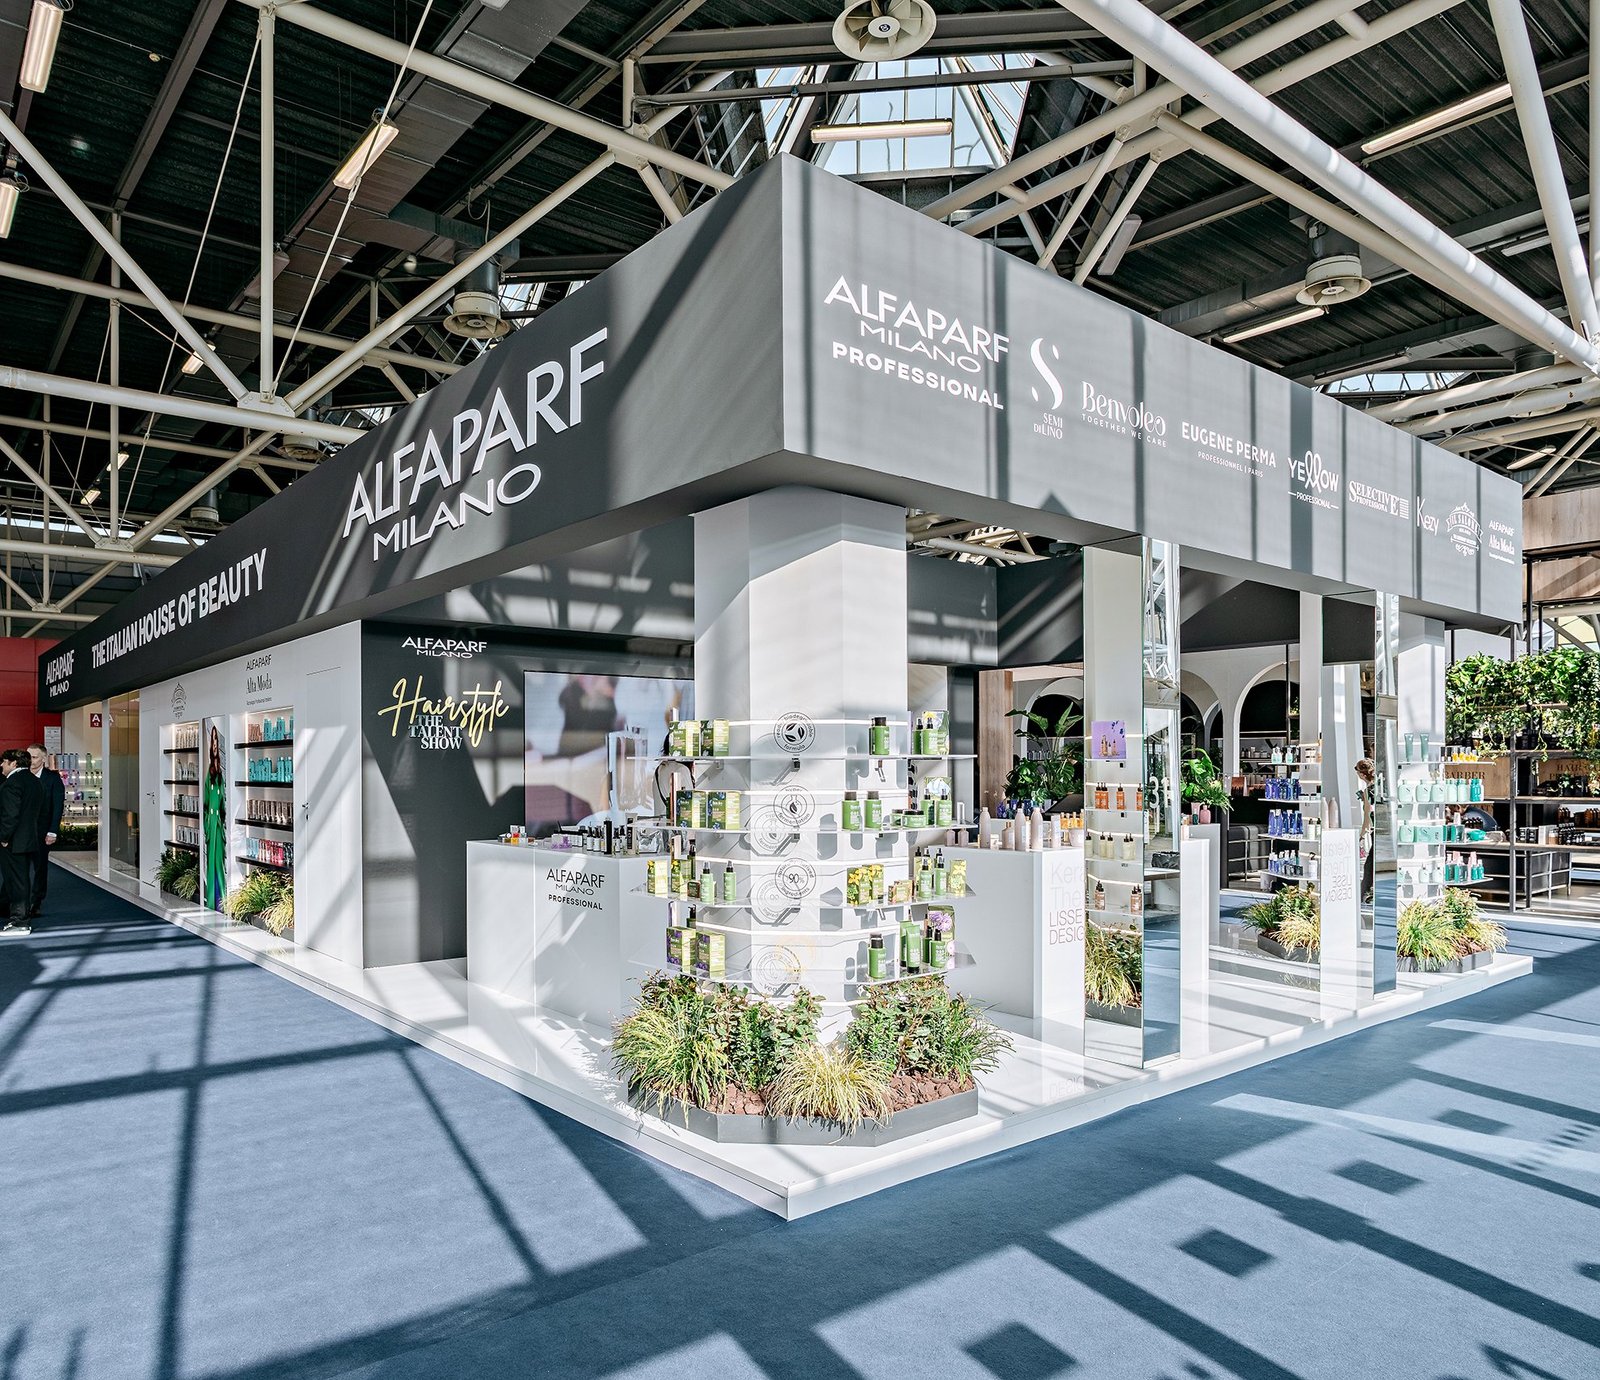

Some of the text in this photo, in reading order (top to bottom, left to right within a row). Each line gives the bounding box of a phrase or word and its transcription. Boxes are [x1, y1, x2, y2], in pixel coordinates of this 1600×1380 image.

[823, 275, 1010, 363] ALFAPARF
[860, 320, 982, 373] MILANO
[832, 341, 1005, 411] PROFESSIONAL
[1043, 412, 1063, 429] SEMI
[1081, 381, 1166, 437] Benvoleo
[342, 327, 608, 539] ALFAPARF
[1082, 413, 1167, 448] TOGETHER WE CARE
[1182, 421, 1277, 468] EUGENE PERMA
[1247, 467, 1264, 478] PARIS
[1296, 491, 1331, 509] PROFESSIONAL
[1348, 480, 1401, 516] SELECTIVE
[373, 463, 542, 561] MILANO
[1417, 495, 1439, 536] Kezy
[91, 547, 267, 669] THE ITALIAN HOUSE OF BEAUTY
[401, 636, 488, 653] ALFAPARF
[416, 649, 473, 659] MILANO
[45, 650, 75, 685] ALFAPARF
[50, 680, 70, 697] MILANO
[377, 675, 510, 748] Hairstyle
[415, 714, 444, 727] THE
[408, 725, 463, 738] TALENT
[420, 737, 463, 750] SHOW
[546, 868, 605, 888] ALFAPARF
[555, 884, 594, 896] MILANO
[549, 894, 603, 910] PROFESSIONAL
[1049, 908, 1083, 928] LISSE
